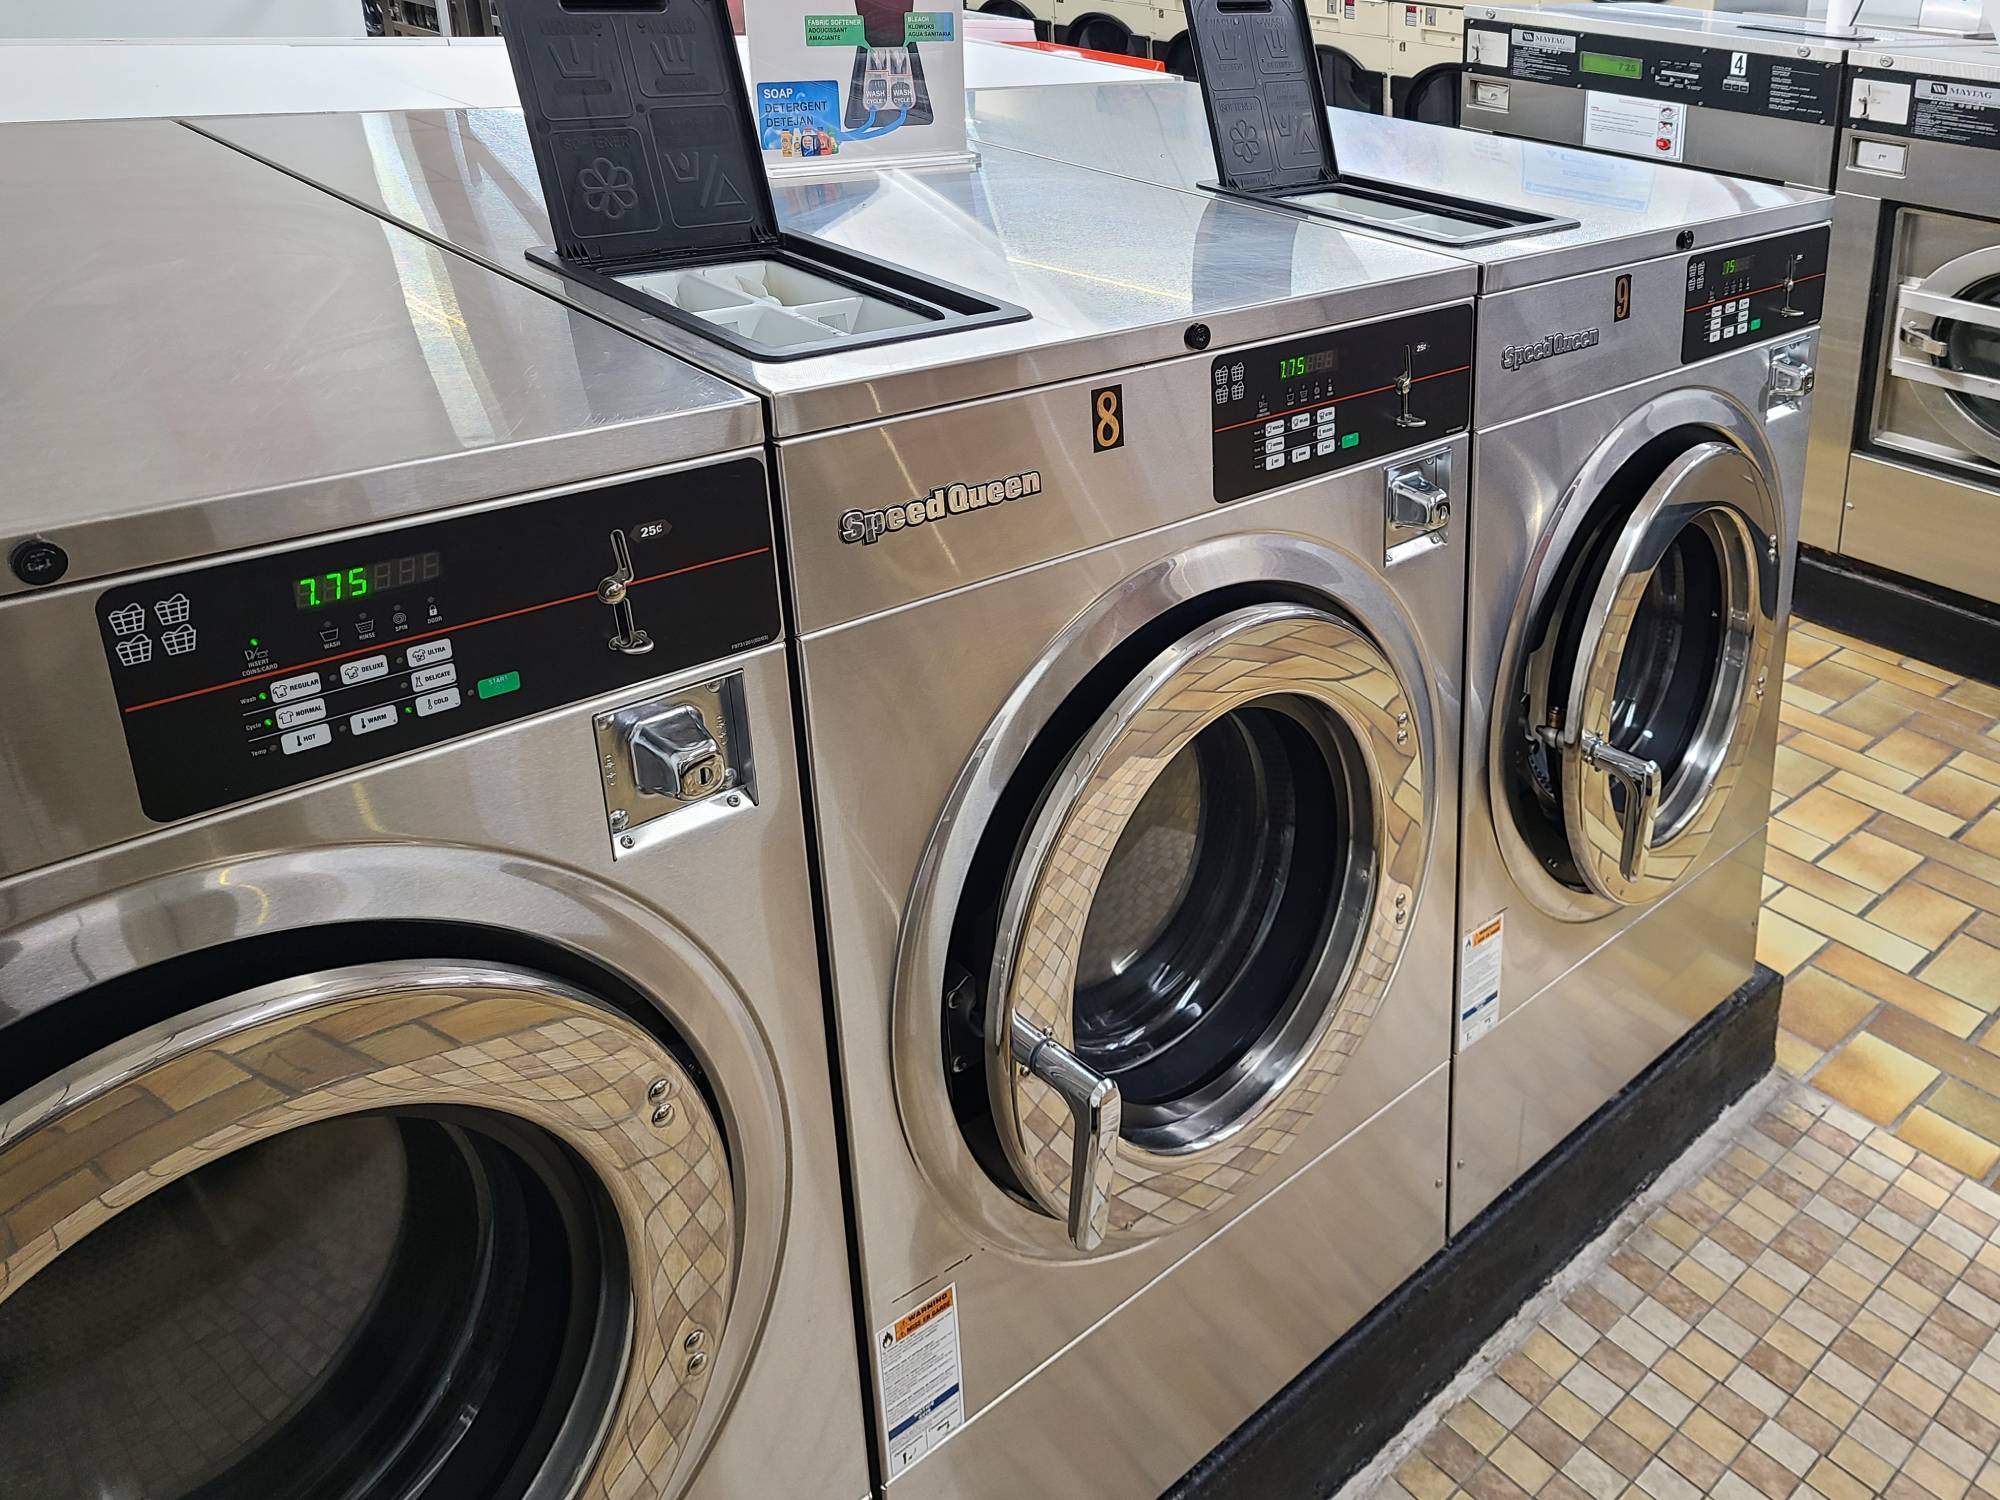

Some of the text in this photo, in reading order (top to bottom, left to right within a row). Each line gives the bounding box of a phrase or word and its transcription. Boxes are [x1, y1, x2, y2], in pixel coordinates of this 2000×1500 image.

[1535, 35, 1565, 45] MAYTAG
[1734, 54, 1744, 74] 4
[763, 88, 793, 99] SOAP
[865, 90, 886, 98] WASH
[1949, 87, 1992, 99] MAYTAG
[765, 101, 828, 113] DETERGENT
[766, 116, 814, 127] DETEJAN
[1615, 277, 1629, 318] 9
[1501, 328, 1599, 371] Speed Queen
[1096, 390, 1120, 448] 8
[839, 469, 1042, 545] Speed Queen
[640, 523, 663, 538] 25¢
[300, 567, 367, 606] 7.75
[427, 616, 442, 624] DOOR
[395, 624, 408, 632] SPIN
[359, 632, 376, 640] RINSE
[323, 640, 341, 649] WASH
[427, 646, 446, 656] ULTRA
[248, 658, 270, 668] INSERT
[361, 661, 385, 673] DELUXE
[425, 671, 451, 682] DELICATE
[488, 675, 508, 685] START
[289, 679, 319, 691] REGULAR
[240, 695, 257, 705] Wash
[433, 696, 449, 705] COLD
[295, 704, 323, 717] NORMAL
[367, 713, 387, 724] WARM
[245, 722, 262, 732] Cycle
[303, 733, 316, 742] HOT
[251, 748, 267, 757] Temp
[908, 1293, 947, 1321] WARNING
